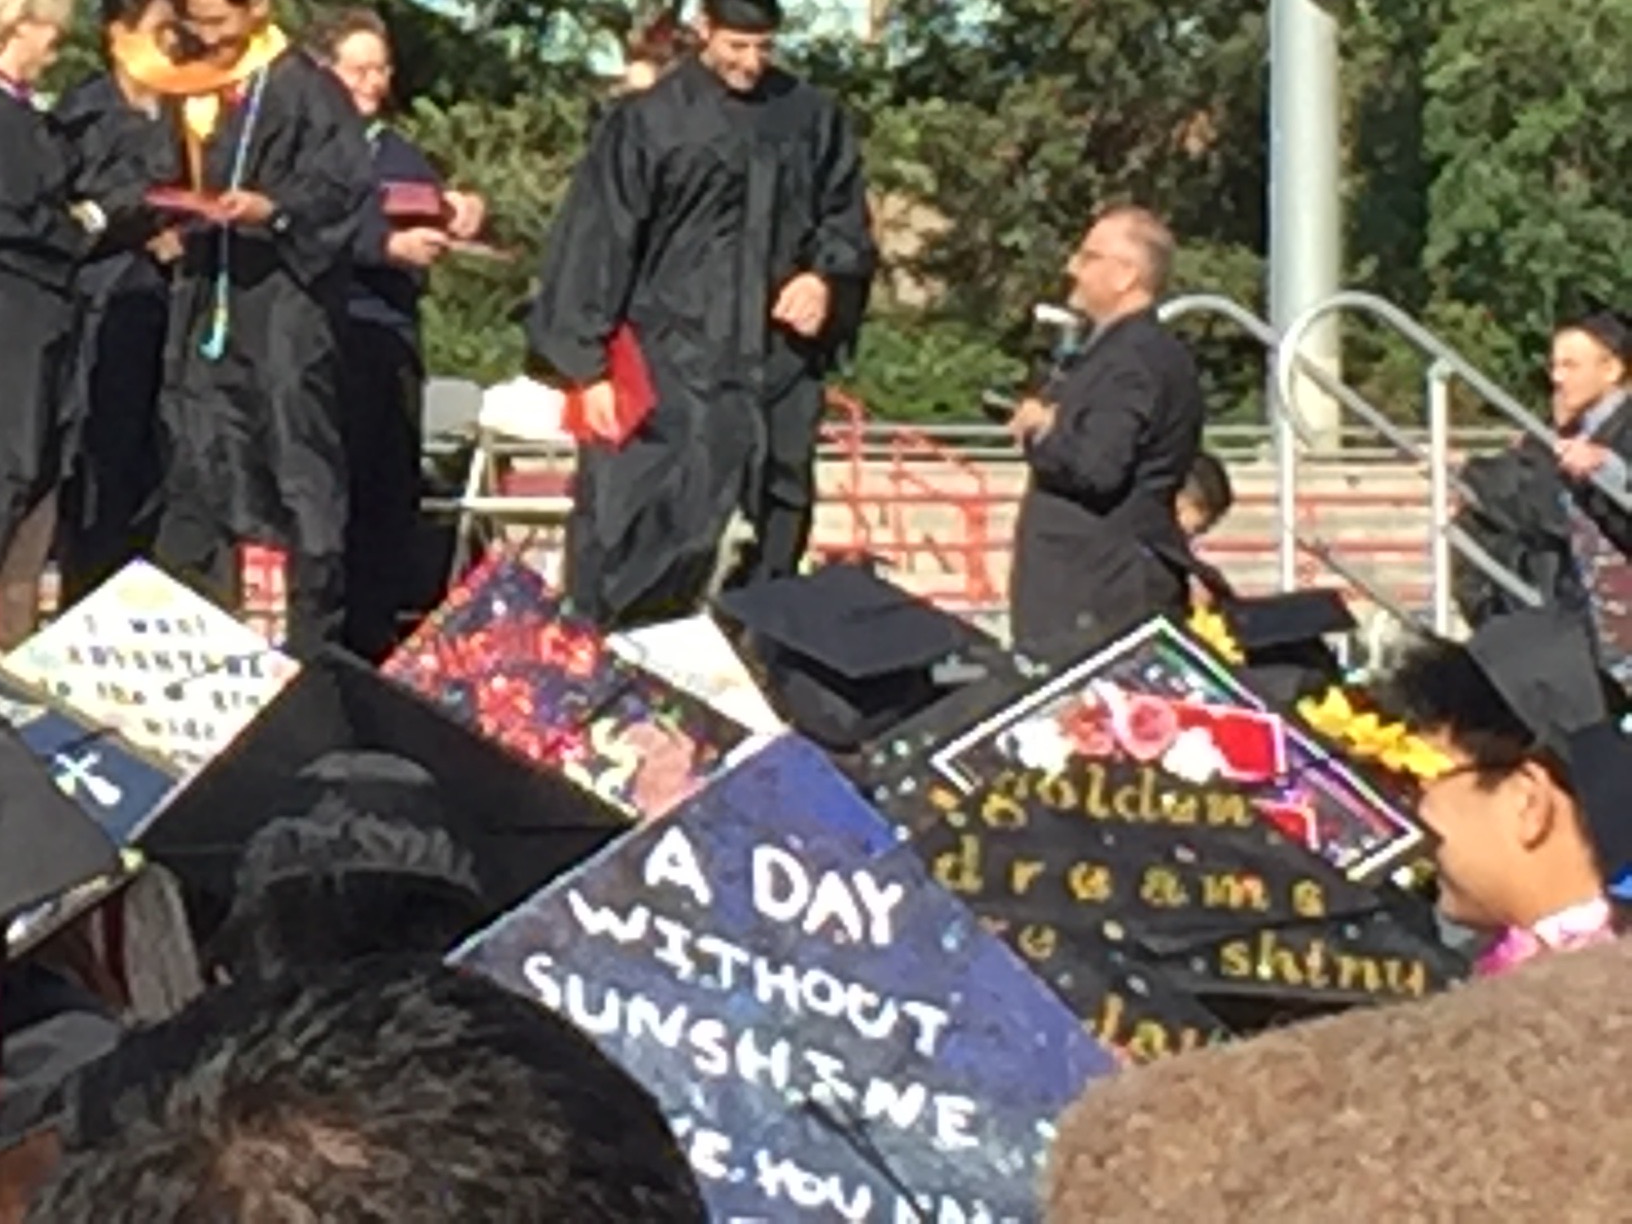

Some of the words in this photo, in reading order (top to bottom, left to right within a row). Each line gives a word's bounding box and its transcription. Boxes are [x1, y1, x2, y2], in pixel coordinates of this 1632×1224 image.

[644, 825, 713, 907] A
[750, 843, 905, 946] DAY
[567, 888, 948, 1057] WITHOUT
[522, 954, 979, 1151] SUNSHINE
[755, 1149, 874, 1223] YOU
